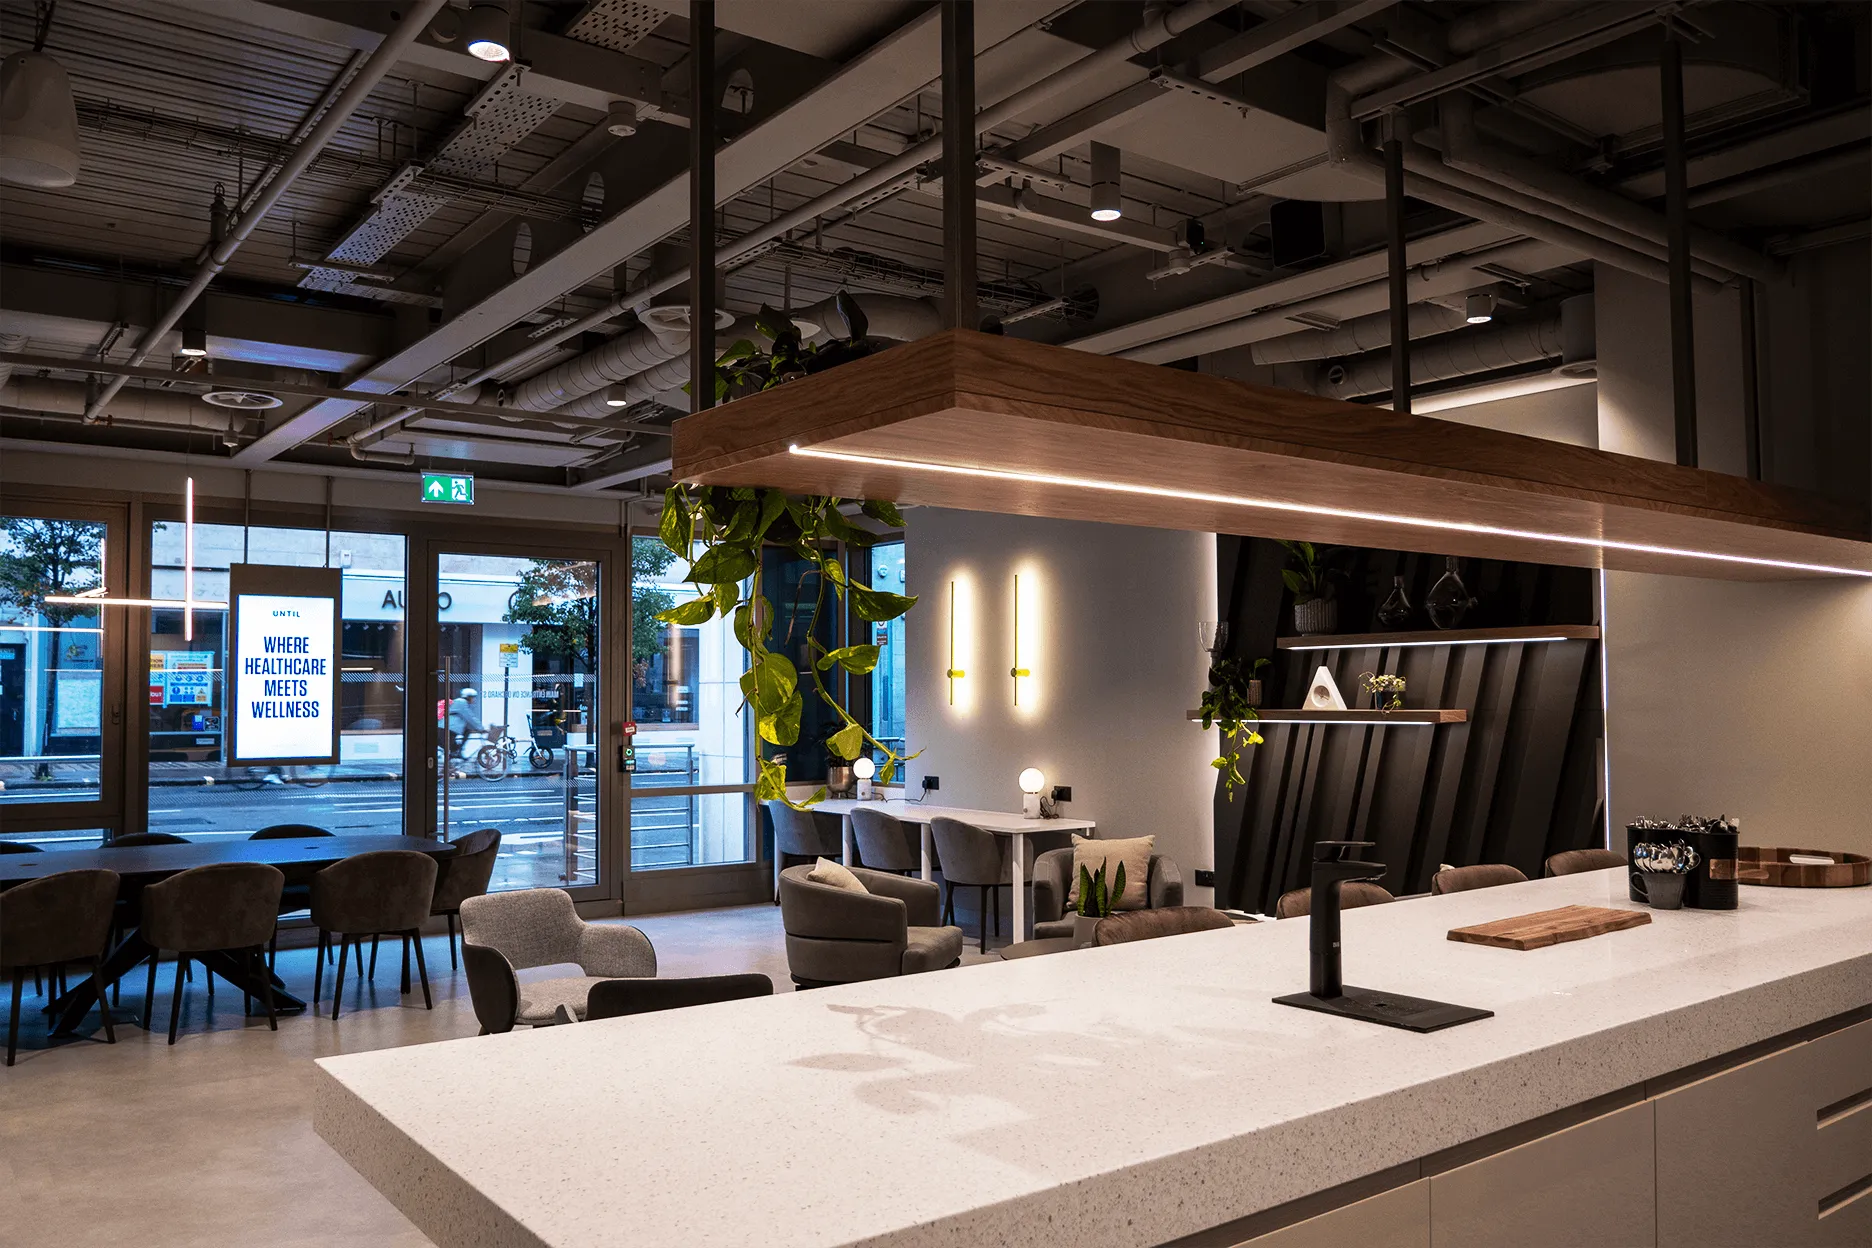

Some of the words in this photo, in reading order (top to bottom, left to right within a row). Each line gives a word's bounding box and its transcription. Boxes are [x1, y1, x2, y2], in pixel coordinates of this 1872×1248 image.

[272, 610, 301, 618] UNTIL
[263, 636, 310, 654] WHERE
[244, 657, 327, 675] HEALTHCARE
[264, 679, 308, 697] MEETS
[251, 701, 320, 718] WELLNESS
